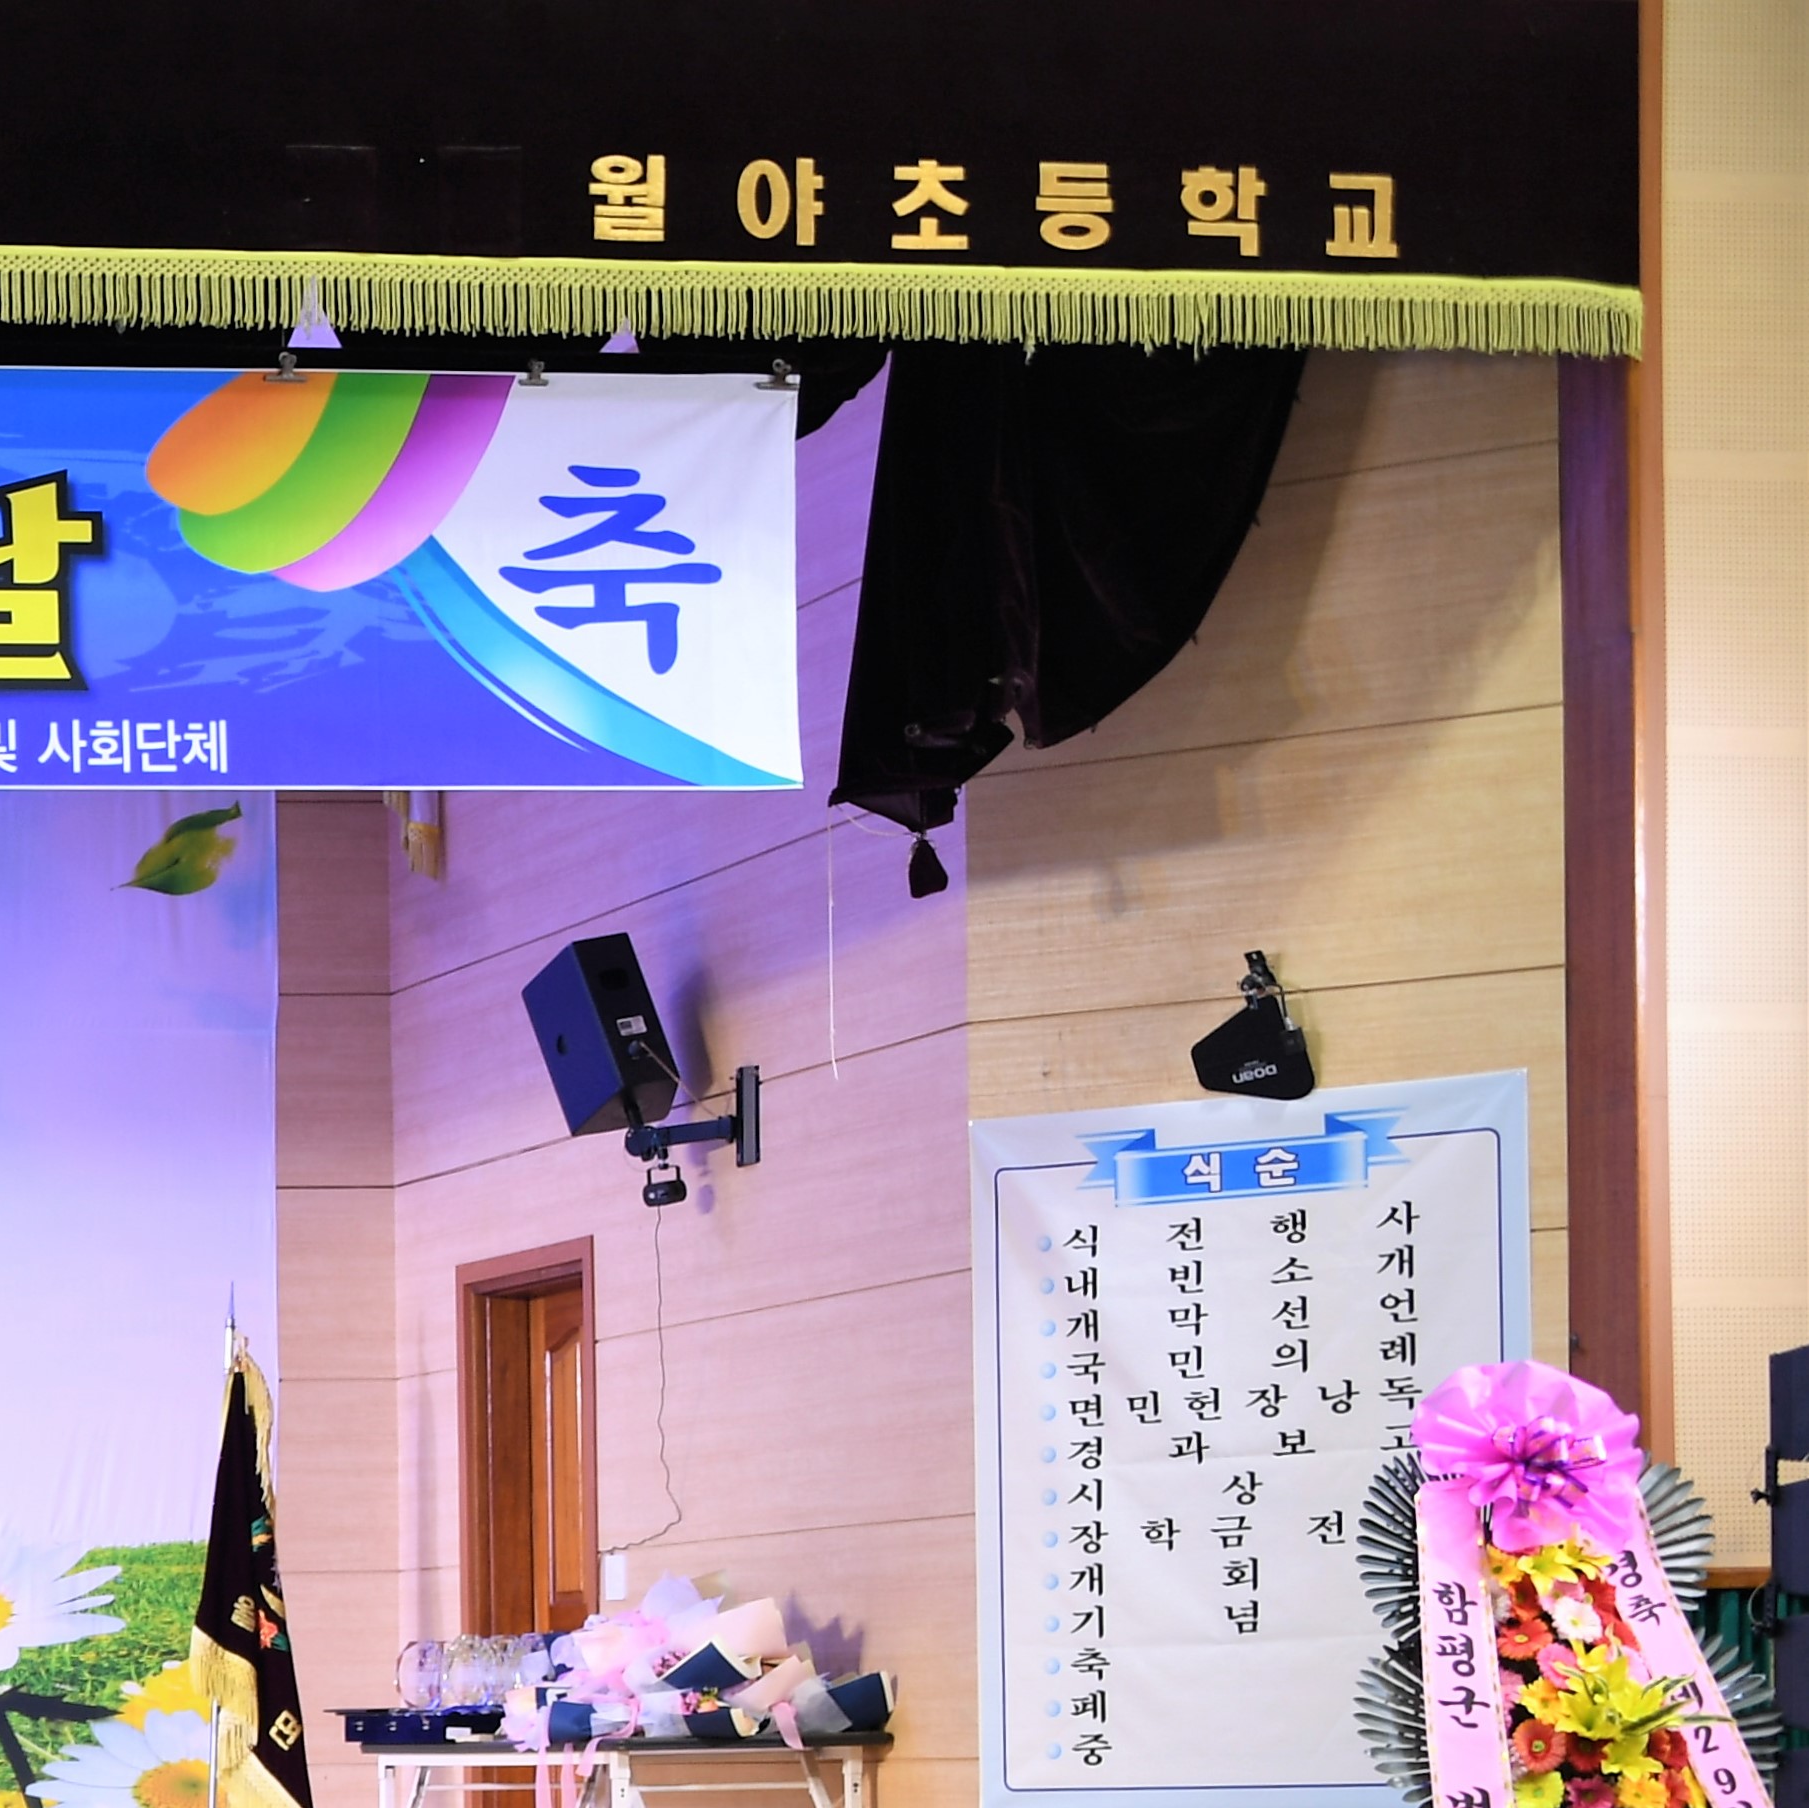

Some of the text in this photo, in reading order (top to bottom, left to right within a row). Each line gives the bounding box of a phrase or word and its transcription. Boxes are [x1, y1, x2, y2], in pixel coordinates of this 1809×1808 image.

[498, 465, 723, 675] 축
[38, 718, 229, 774] 사회단체
[1432, 1580, 1491, 1729] 함평군
